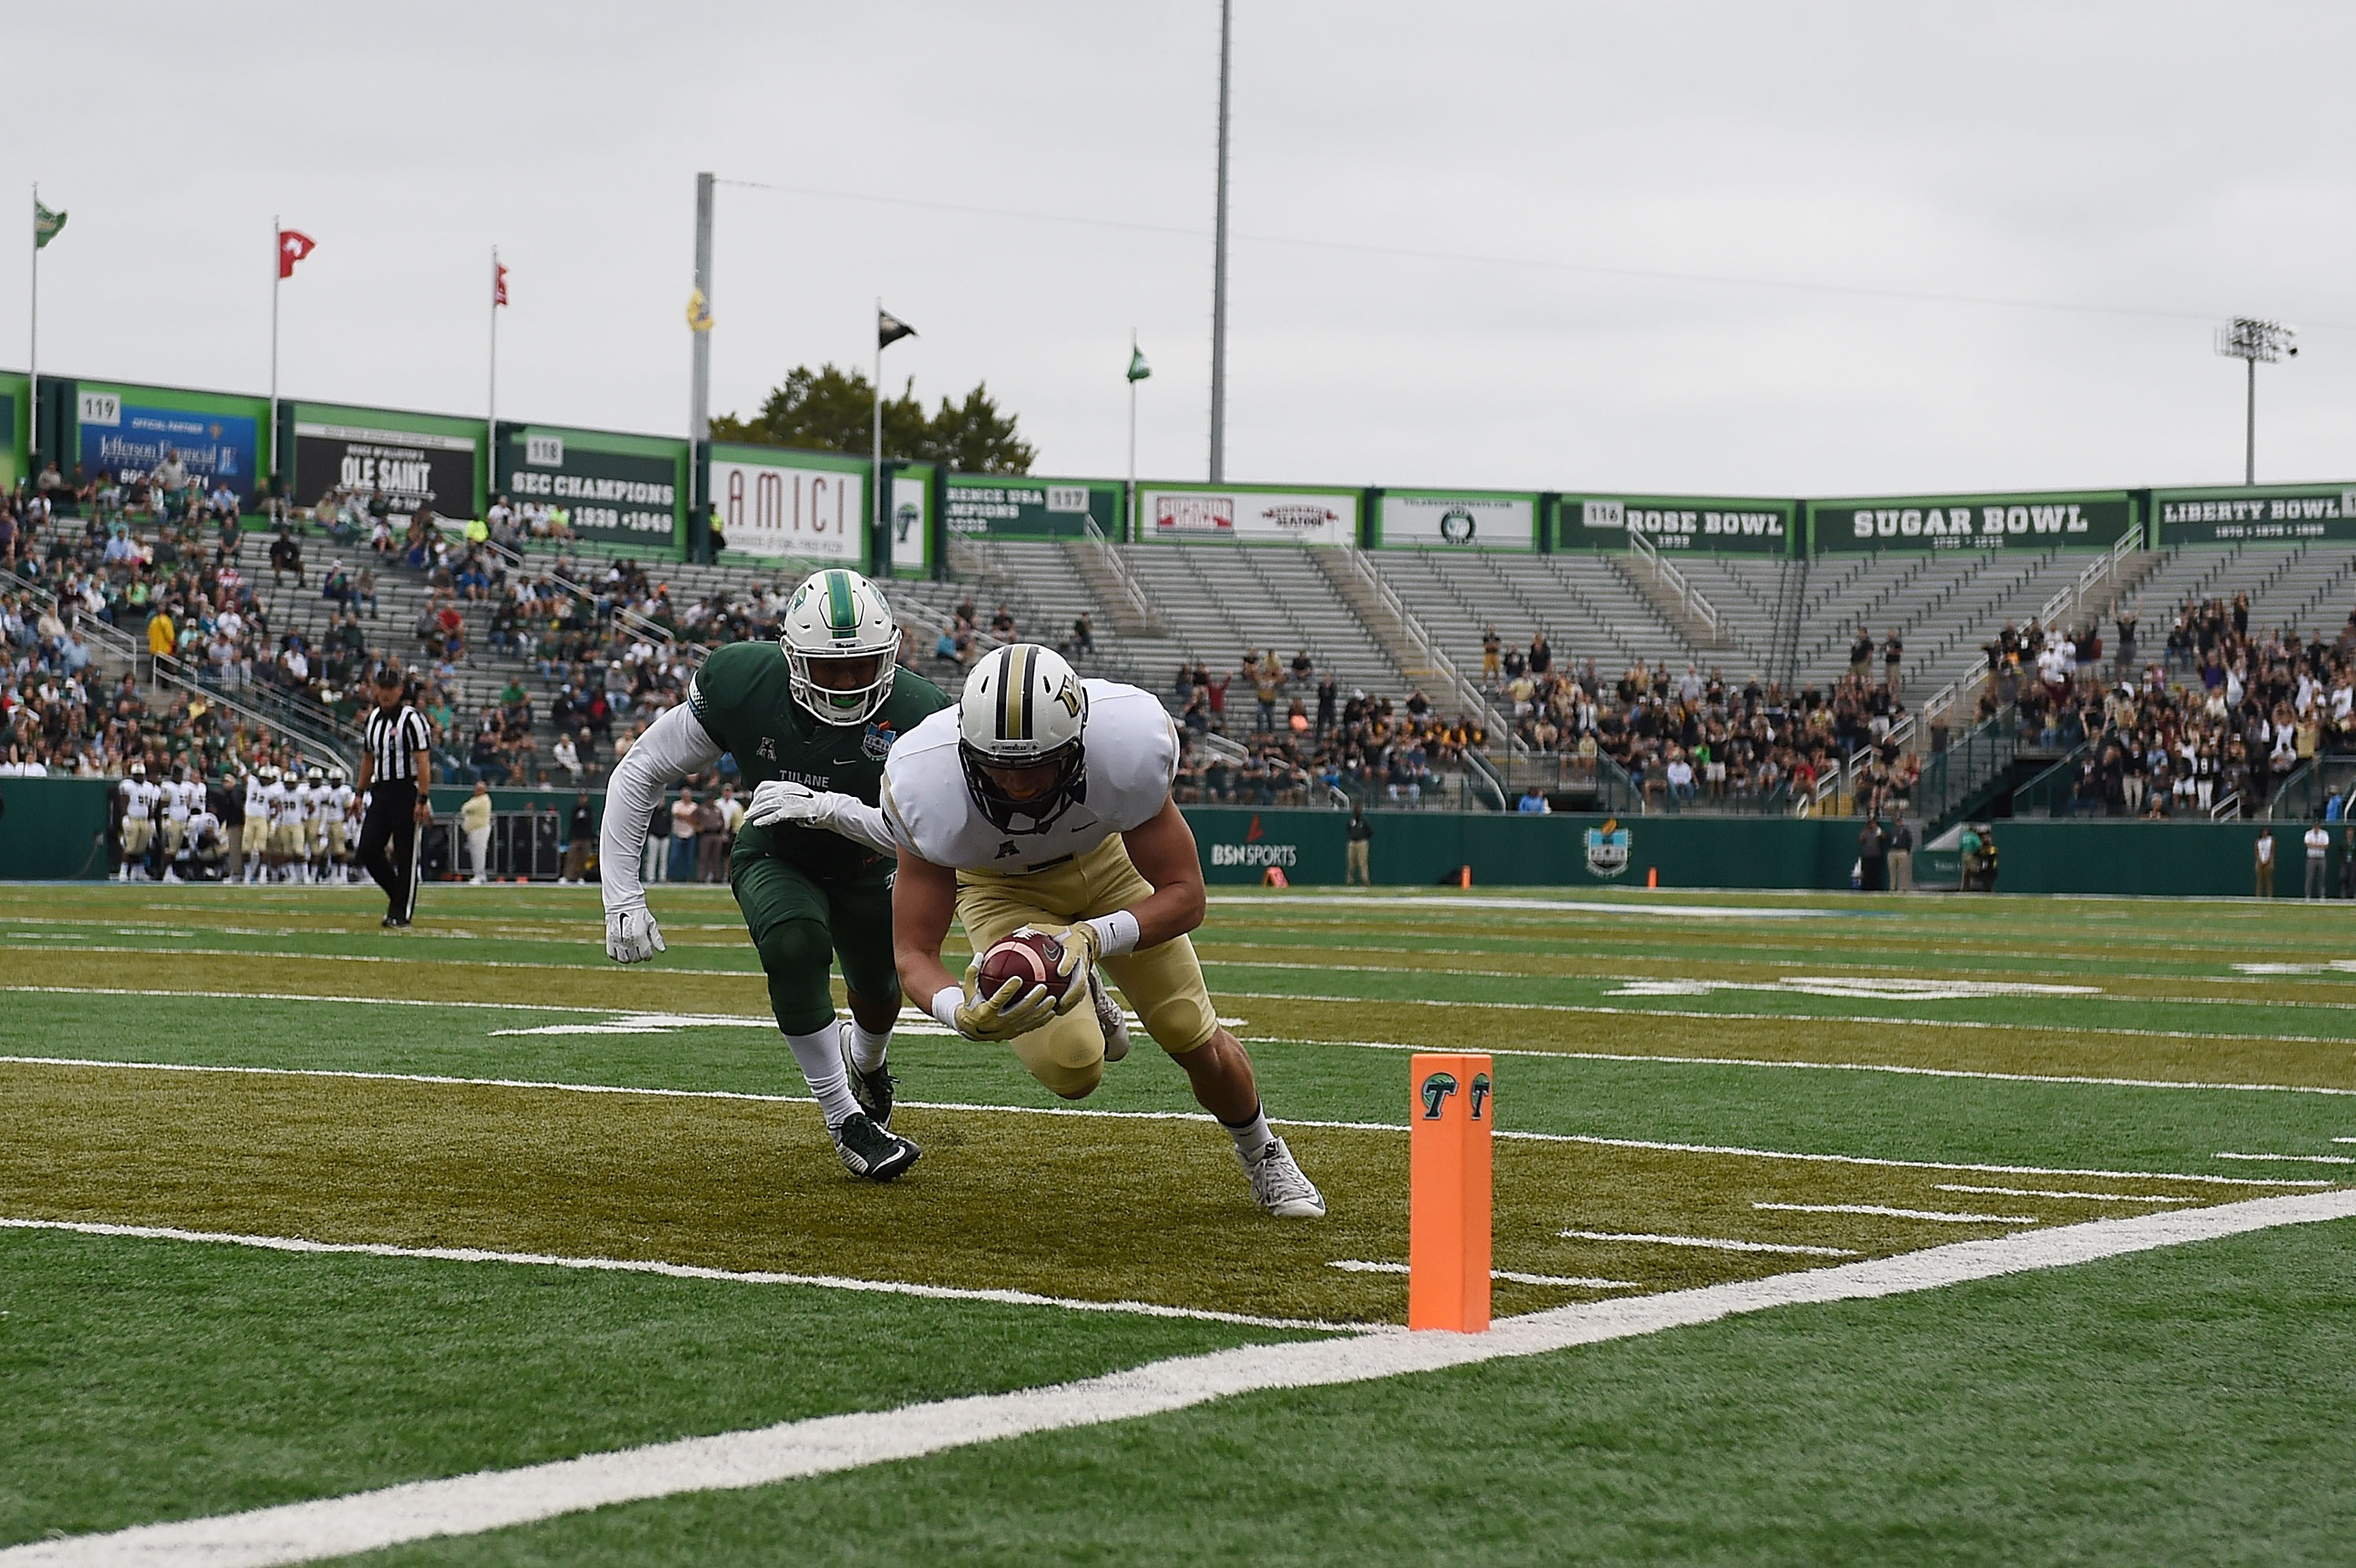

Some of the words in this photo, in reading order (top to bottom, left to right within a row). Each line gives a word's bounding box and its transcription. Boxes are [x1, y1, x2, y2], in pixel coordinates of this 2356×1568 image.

[86, 398, 115, 418] 119
[100, 433, 157, 459] Jefferson
[159, 440, 218, 465] Fnancial
[532, 440, 558, 459] 118
[341, 455, 375, 488] OLE
[378, 458, 432, 493] SAINT
[511, 471, 552, 495] SEC
[554, 474, 675, 506] CHAMPIONS
[728, 468, 844, 534] AMICI
[1007, 489, 1044, 505] USA
[1053, 490, 1084, 507] 117
[1590, 505, 1618, 524] 116
[1626, 510, 1697, 534] ROSE
[1704, 511, 1783, 536] BOWL
[1853, 507, 1973, 538] SUGAR
[1982, 504, 2088, 535] BOWL
[2164, 500, 2265, 524] LIBERTY
[2270, 498, 2340, 520] BOWL
[779, 769, 830, 788] TULANE
[1211, 843, 1246, 866] BSN
[1246, 844, 1297, 867] SPORTS
